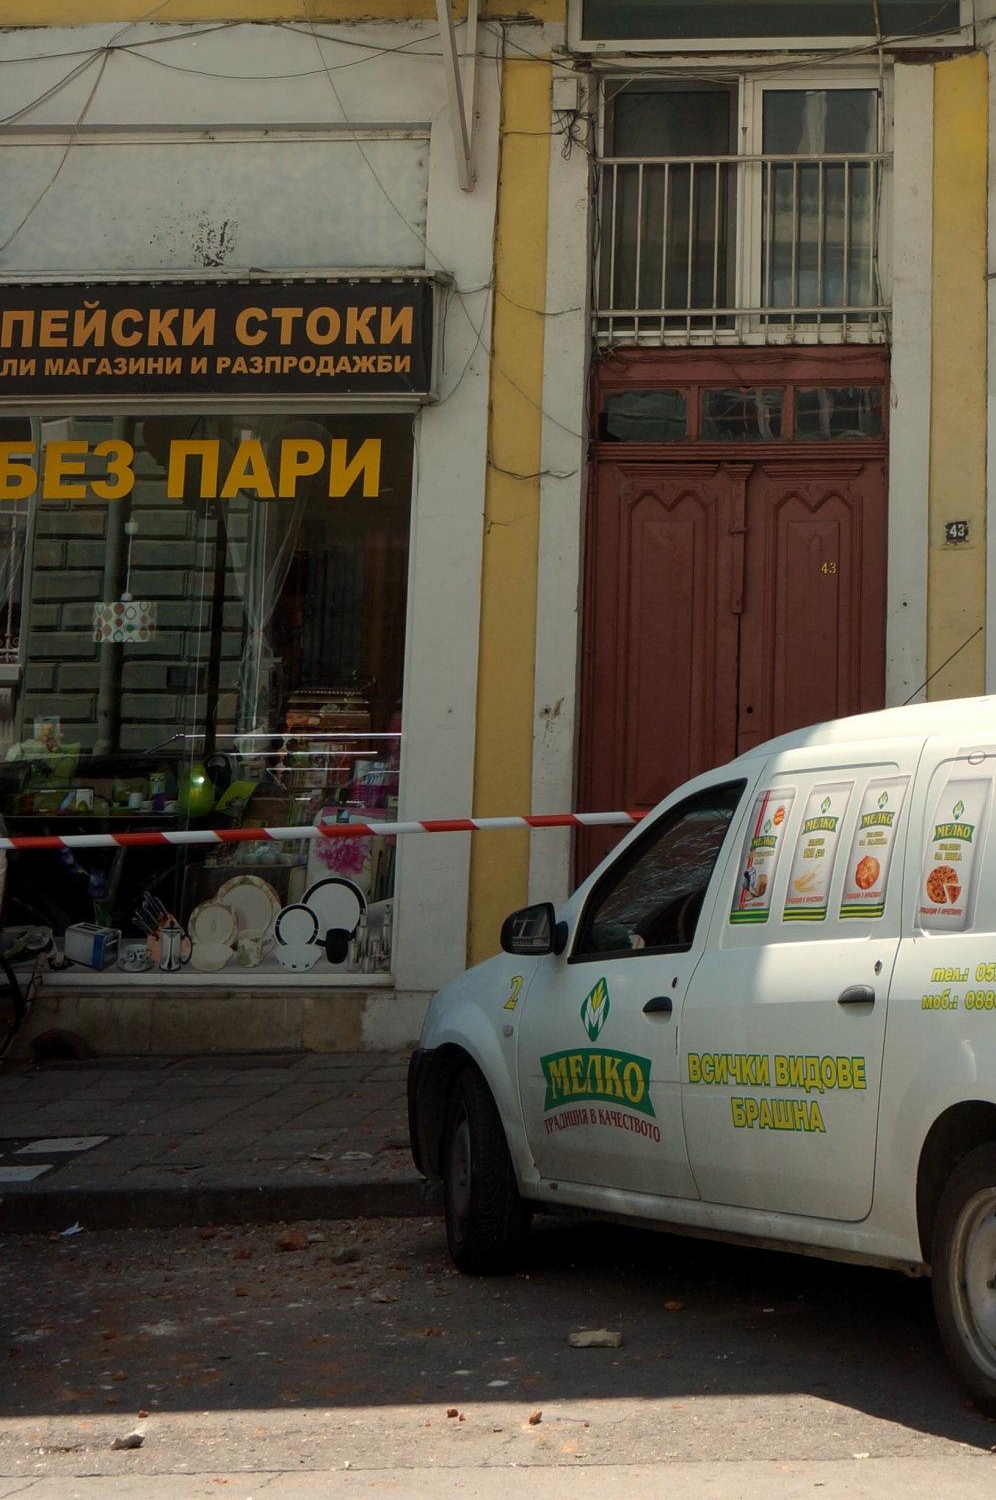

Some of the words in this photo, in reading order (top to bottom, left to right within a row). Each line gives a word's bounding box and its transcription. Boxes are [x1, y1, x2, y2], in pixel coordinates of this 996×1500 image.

[0, 300, 217, 349] ПЕЙСКИ
[235, 306, 414, 346] СТОКИ
[44, 356, 182, 377] МАГАЗИНИ
[190, 356, 208, 375] И
[216, 355, 412, 377] РАЗПРОДАЖБИ
[0, 438, 135, 500] БЕЗ
[166, 437, 382, 499] ПАРИ
[949, 523, 965, 538] 43
[821, 562, 837, 574] 43
[502, 975, 525, 1011] 2
[548, 1054, 645, 1104] МЕЛКО
[688, 1052, 770, 1087] ВСИЧКИ
[775, 1054, 867, 1094] ВИДОВЕ
[544, 1108, 588, 1135] ТРАДИЦИЯ
[589, 1108, 597, 1125] В
[598, 1108, 661, 1142] КАЧЕСТВОТО
[731, 1097, 827, 1134] БРАШНА
